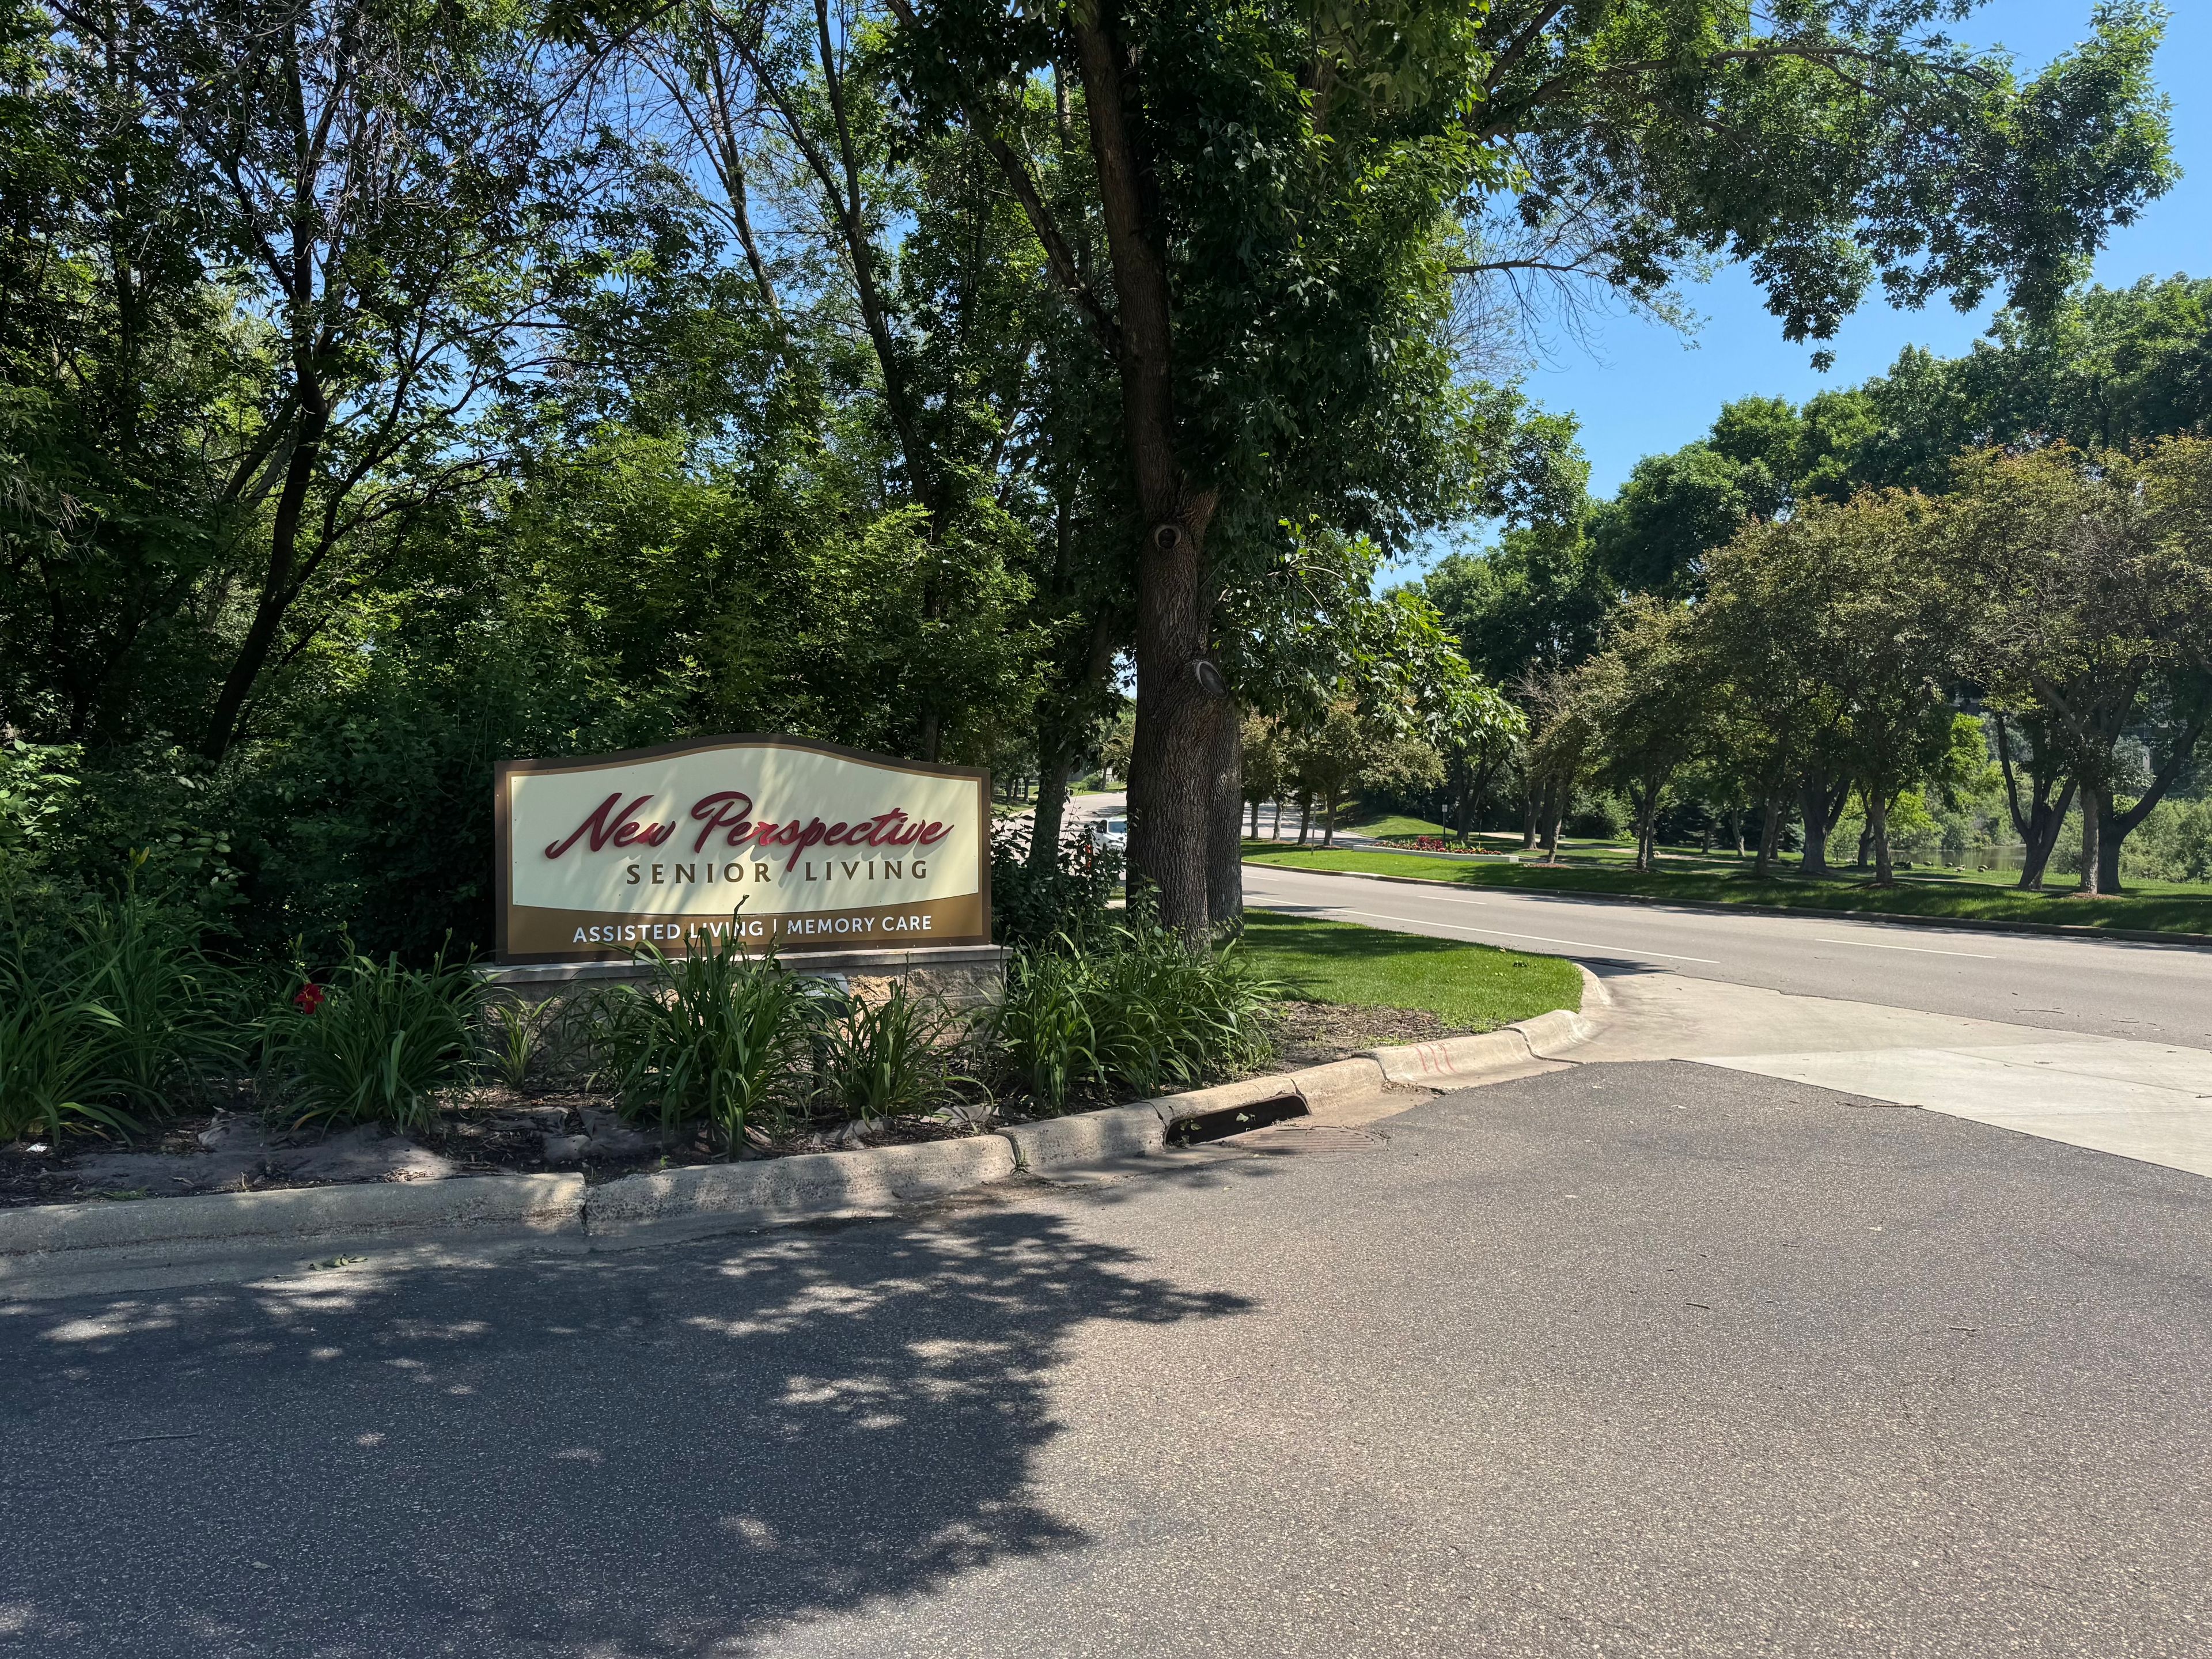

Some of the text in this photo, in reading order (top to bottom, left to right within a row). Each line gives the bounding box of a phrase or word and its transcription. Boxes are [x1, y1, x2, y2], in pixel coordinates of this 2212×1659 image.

[545, 791, 955, 872] New Perspective
[627, 860, 927, 884] SENIOR LIVING
[573, 924, 680, 943] ASSISTED
[787, 917, 876, 935] MEMORY
[882, 915, 931, 931] CARE
